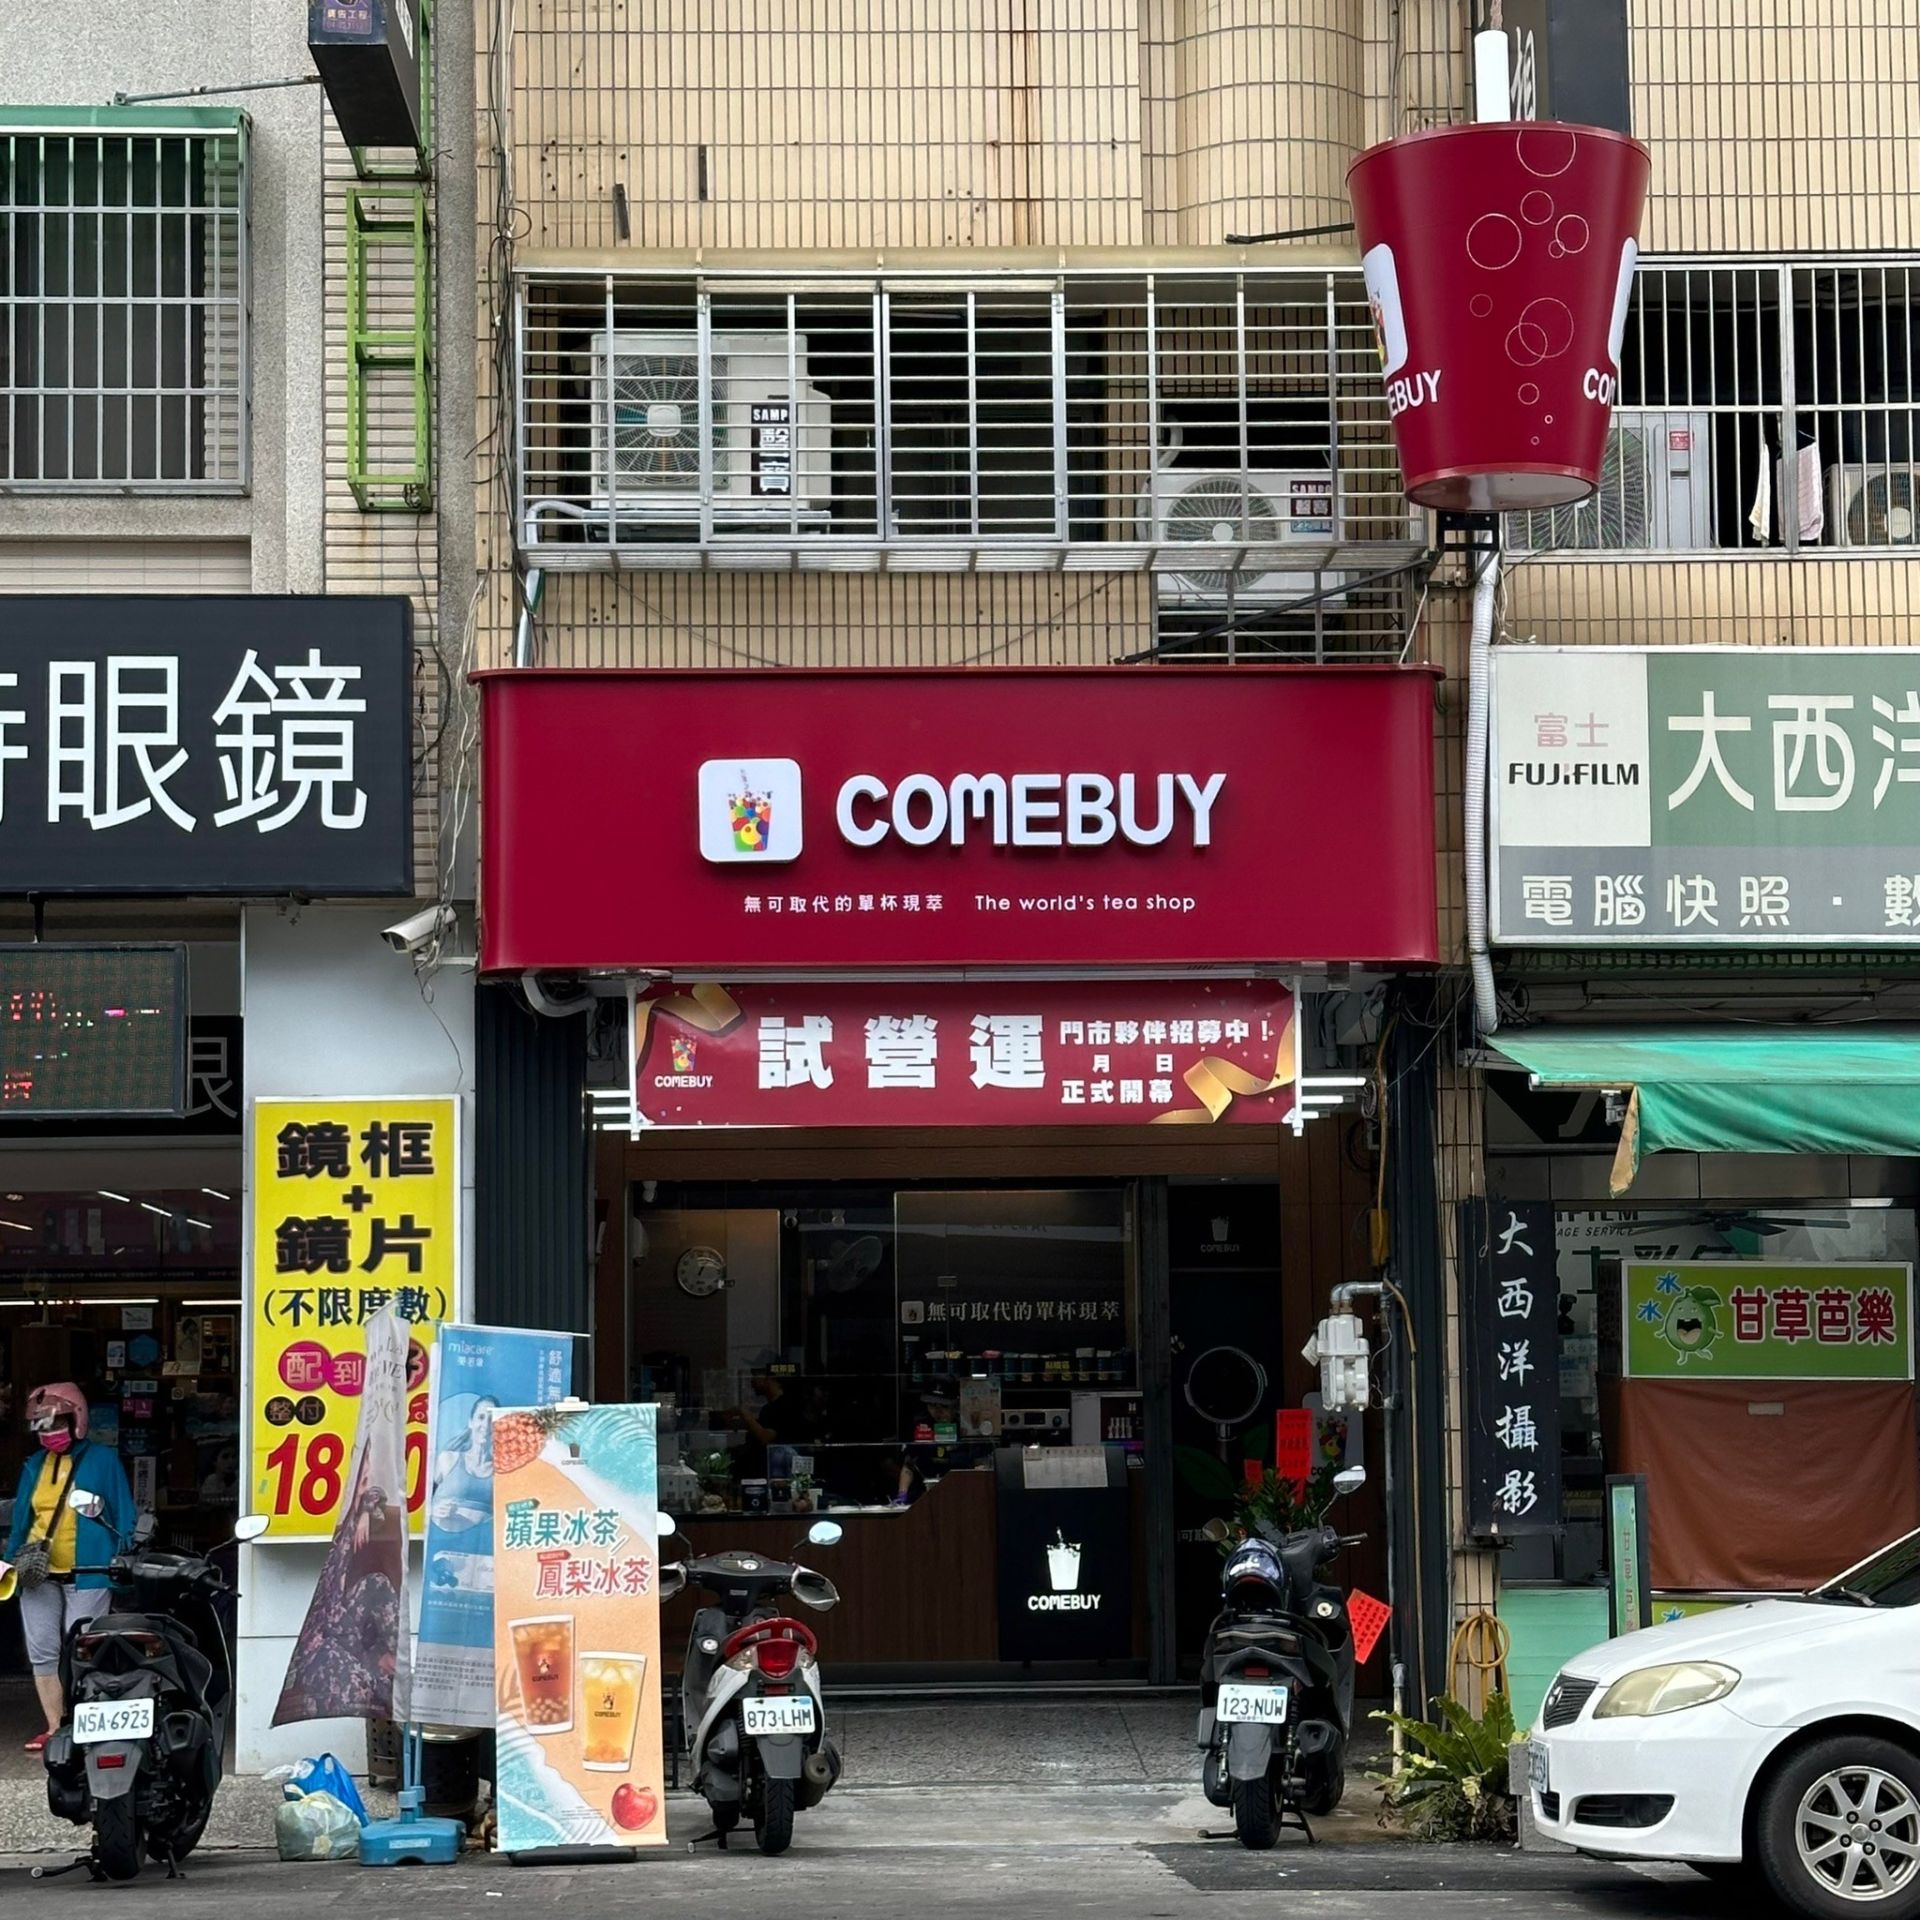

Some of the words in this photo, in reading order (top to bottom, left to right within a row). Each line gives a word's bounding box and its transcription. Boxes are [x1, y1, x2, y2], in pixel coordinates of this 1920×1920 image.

[753, 408, 789, 421] SAMP
[0, 648, 368, 833] 眼鏡
[1534, 712, 1610, 748] 富士
[1508, 763, 1640, 786] FUJIFILM
[836, 773, 1227, 848] COMEBUY
[743, 895, 944, 913] 無可取代的單杯現萃
[975, 895, 1011, 910] The
[1018, 895, 1096, 911] world's
[1102, 895, 1138, 911] tea
[1146, 894, 1196, 913] shop
[757, 1014, 1046, 1090] 試營運
[1093, 1054, 1111, 1073] 月
[1157, 1054, 1173, 1073] 日
[654, 1075, 714, 1088] COMEBUY
[1061, 1079, 1174, 1104] 正式開幕
[277, 1120, 434, 1178] 鏡框
[275, 1215, 432, 1274] 鏡片
[927, 1301, 1120, 1322] 無可取代的單杯現萃
[1731, 1287, 1896, 1344] 甘草芭樂
[1495, 1211, 1540, 1516] 大西洋攝影
[505, 1509, 619, 1548] 蘋果冰茶
[1028, 1594, 1101, 1610] COMEBUY
